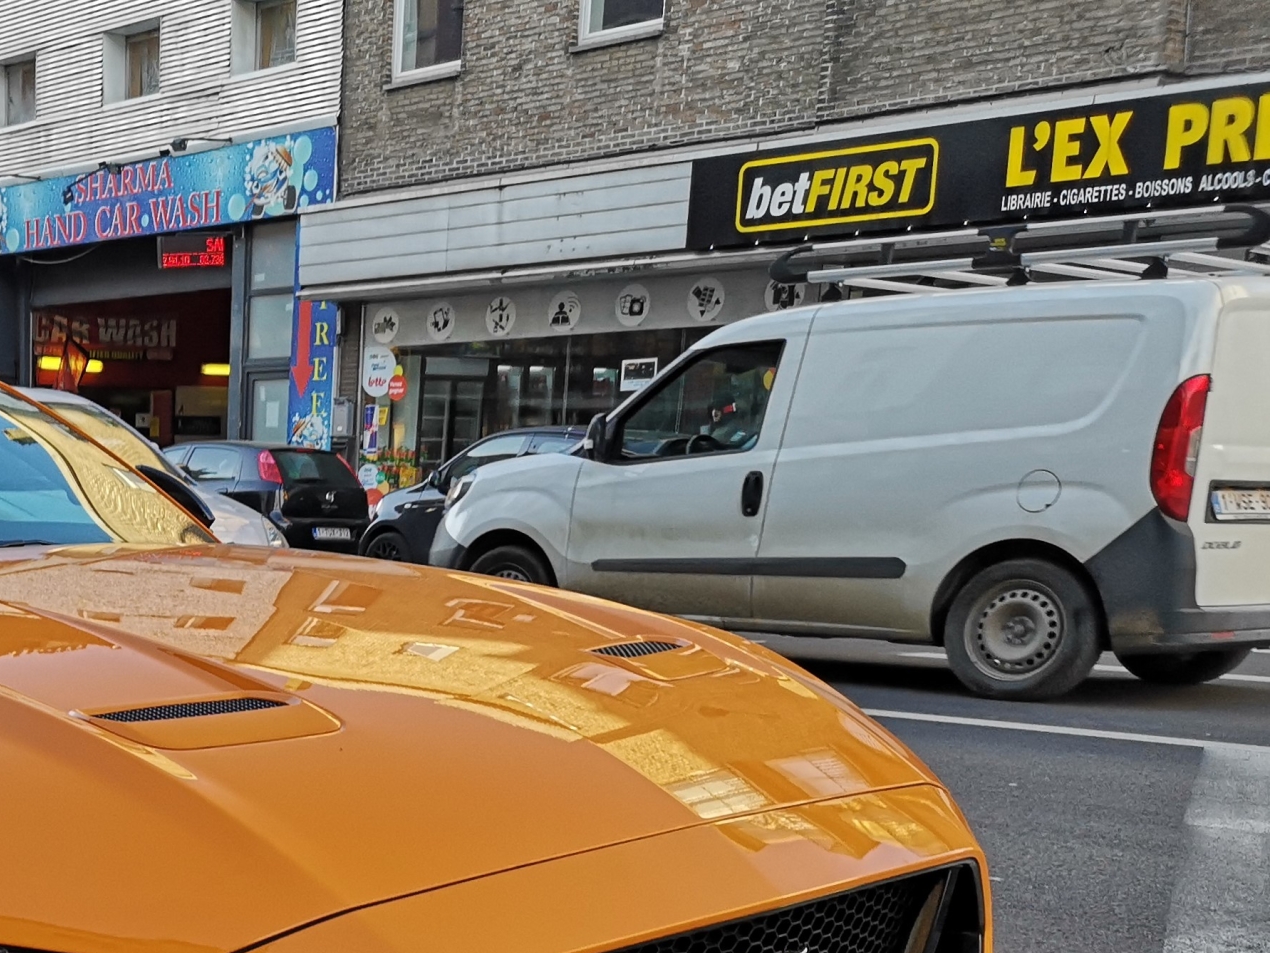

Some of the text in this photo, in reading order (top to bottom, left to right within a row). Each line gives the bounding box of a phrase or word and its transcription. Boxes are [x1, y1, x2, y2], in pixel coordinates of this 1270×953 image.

[1005, 111, 1133, 187] L'EX
[74, 160, 174, 205] SHARMA
[745, 157, 927, 220] betFIRST
[1001, 191, 1052, 212] LIBRAIRIE
[1059, 184, 1127, 206] CIGARETTES
[1134, 176, 1193, 199] BOISSONS
[1198, 169, 1256, 191] ALCOOLS
[23, 189, 222, 250] HAND CAR WASH
[97, 317, 177, 348] WASH
